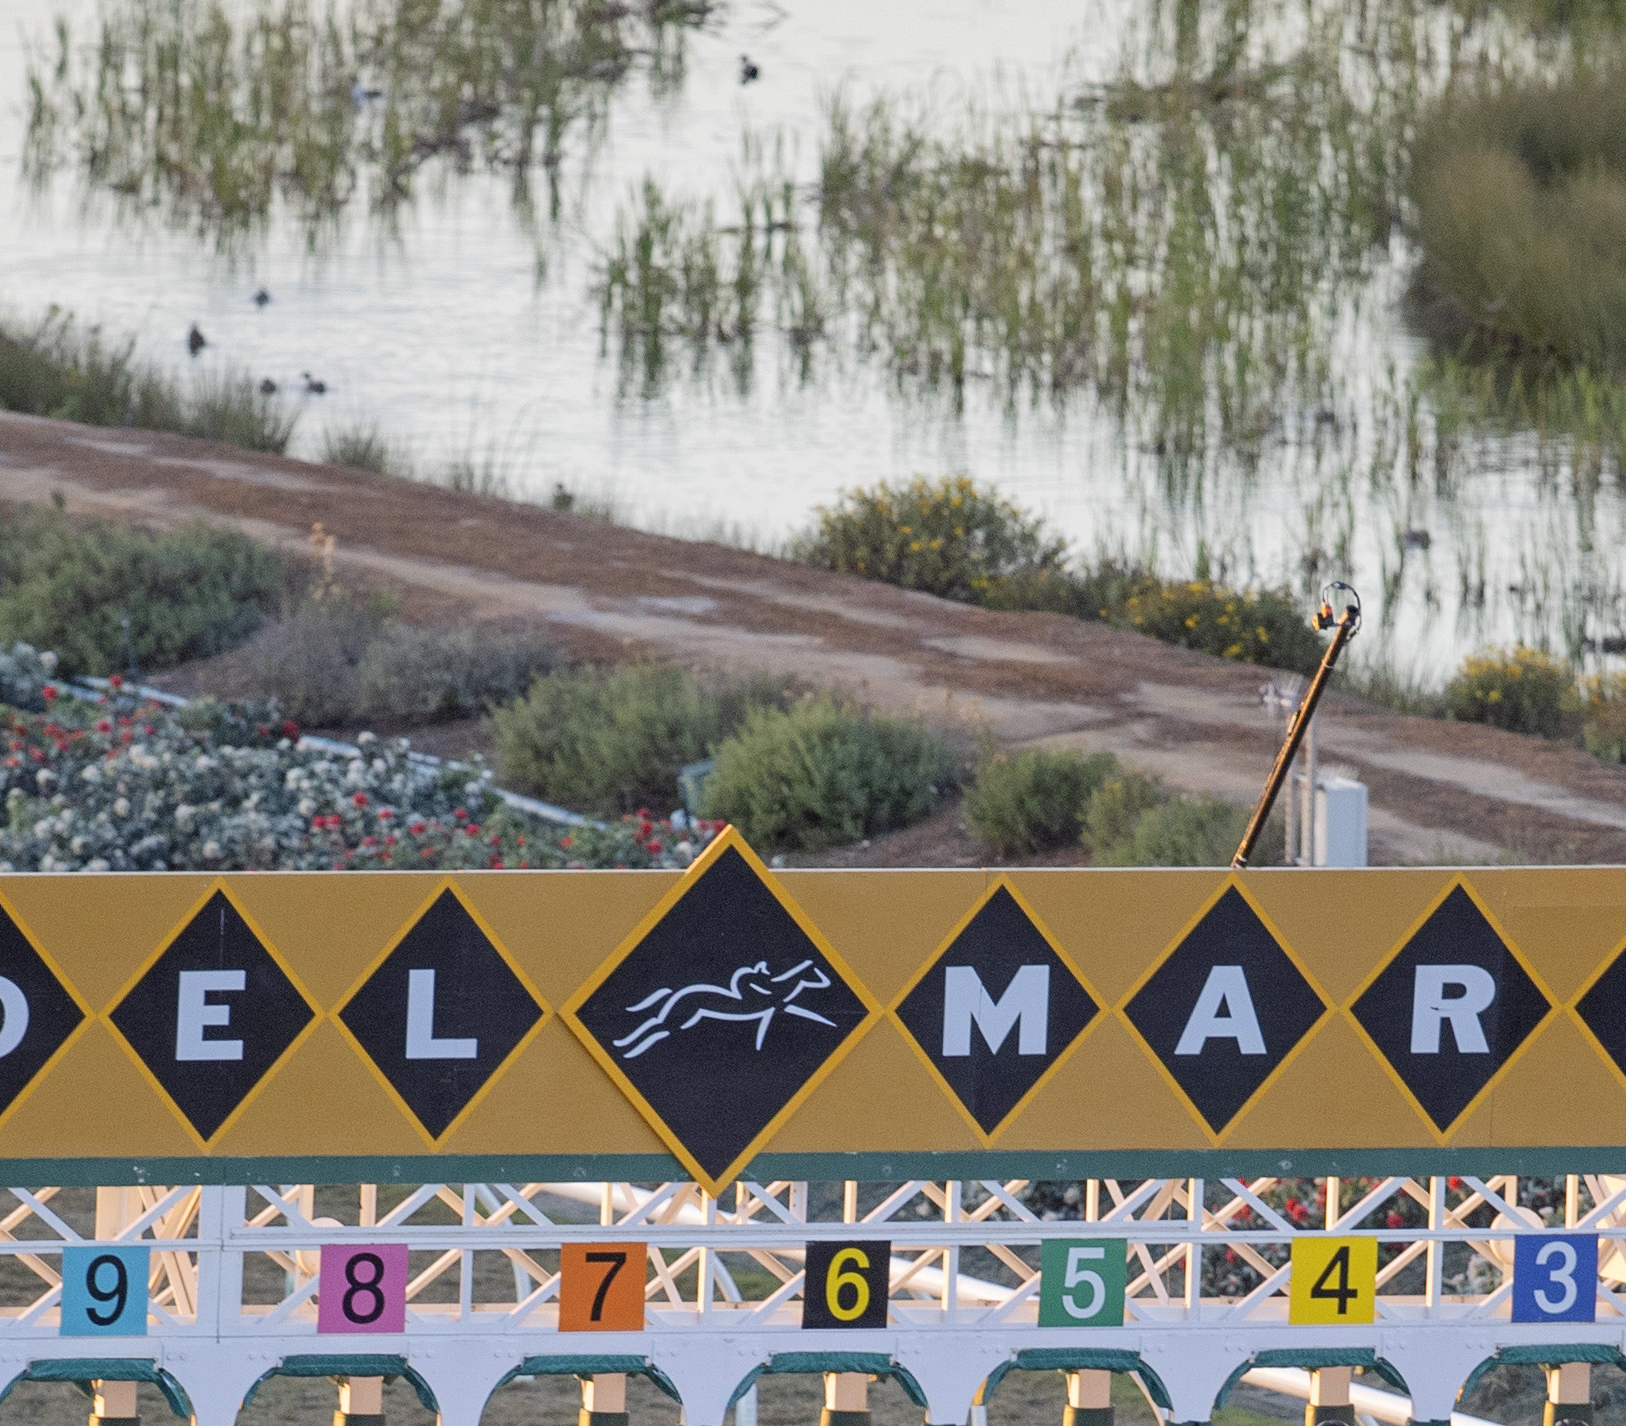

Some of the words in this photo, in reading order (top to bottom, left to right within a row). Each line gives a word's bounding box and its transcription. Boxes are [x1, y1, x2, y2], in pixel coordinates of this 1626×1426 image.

[86, 1255, 128, 1326] 9
[342, 1252, 385, 1325] 8
[585, 1252, 627, 1322] 7
[825, 1247, 870, 1321] 6
[1062, 1247, 1106, 1319] 5
[1310, 1246, 1358, 1315] 4
[1533, 1241, 1578, 1314] 3
